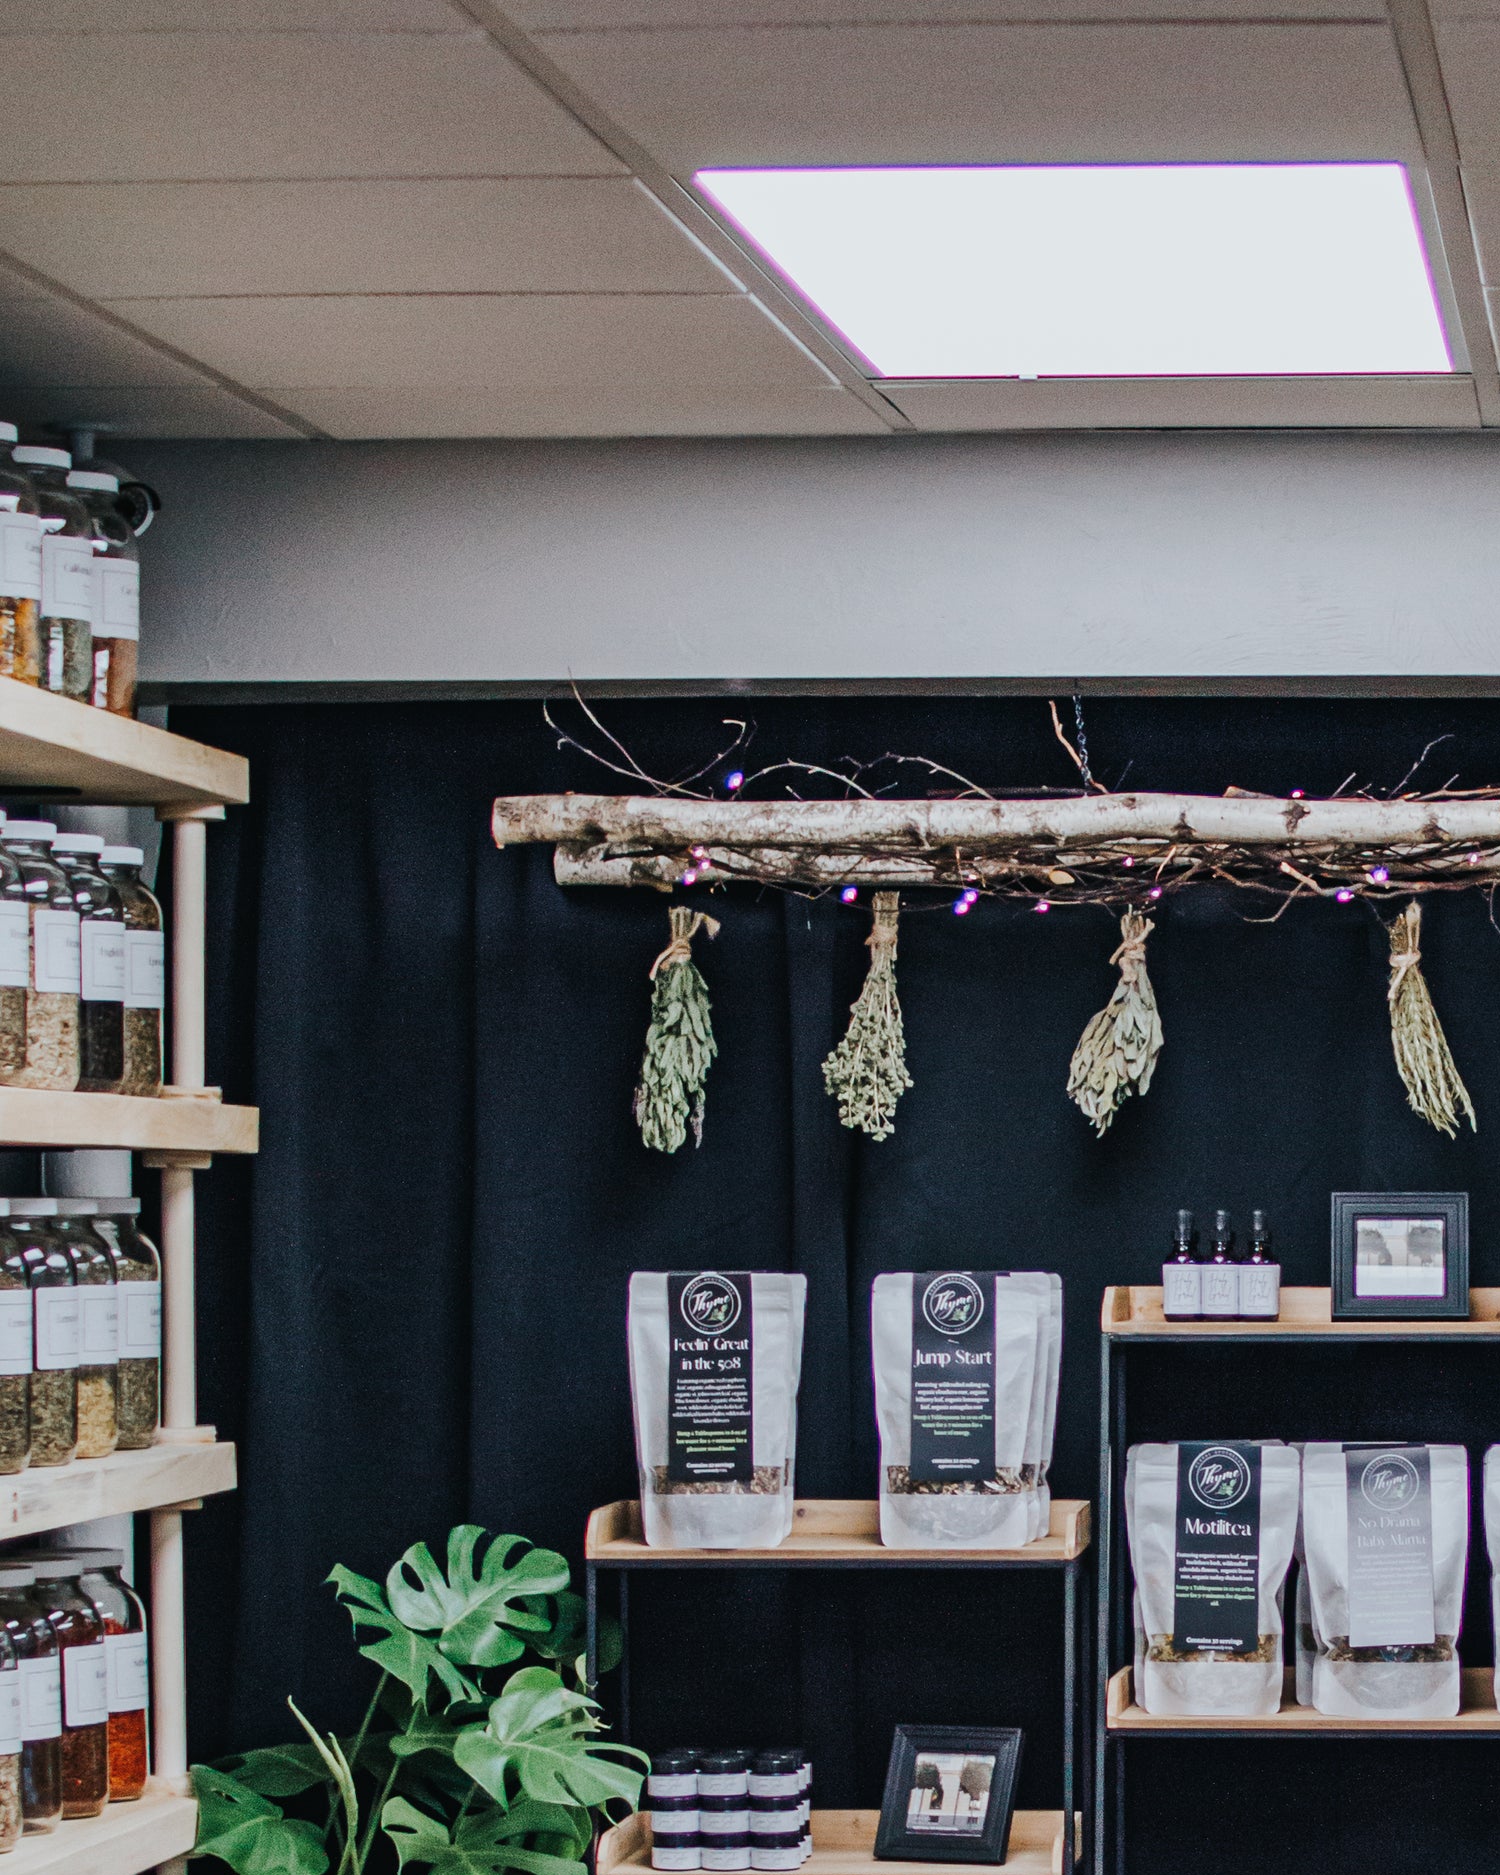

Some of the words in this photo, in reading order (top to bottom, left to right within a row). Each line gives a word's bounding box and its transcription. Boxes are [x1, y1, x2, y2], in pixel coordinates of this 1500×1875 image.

[691, 1290, 730, 1320] Thyme
[933, 1289, 973, 1319] Thyme
[713, 1337, 750, 1351] Great
[682, 1357, 692, 1370] in
[694, 1356, 715, 1370] the
[717, 1356, 741, 1372] 508
[913, 1349, 951, 1368] Jump
[954, 1349, 992, 1365] Start
[1199, 1463, 1239, 1494] Thyme
[1372, 1469, 1408, 1497] Thyme
[1185, 1517, 1252, 1536] Motilitea
[1358, 1517, 1377, 1528] No
